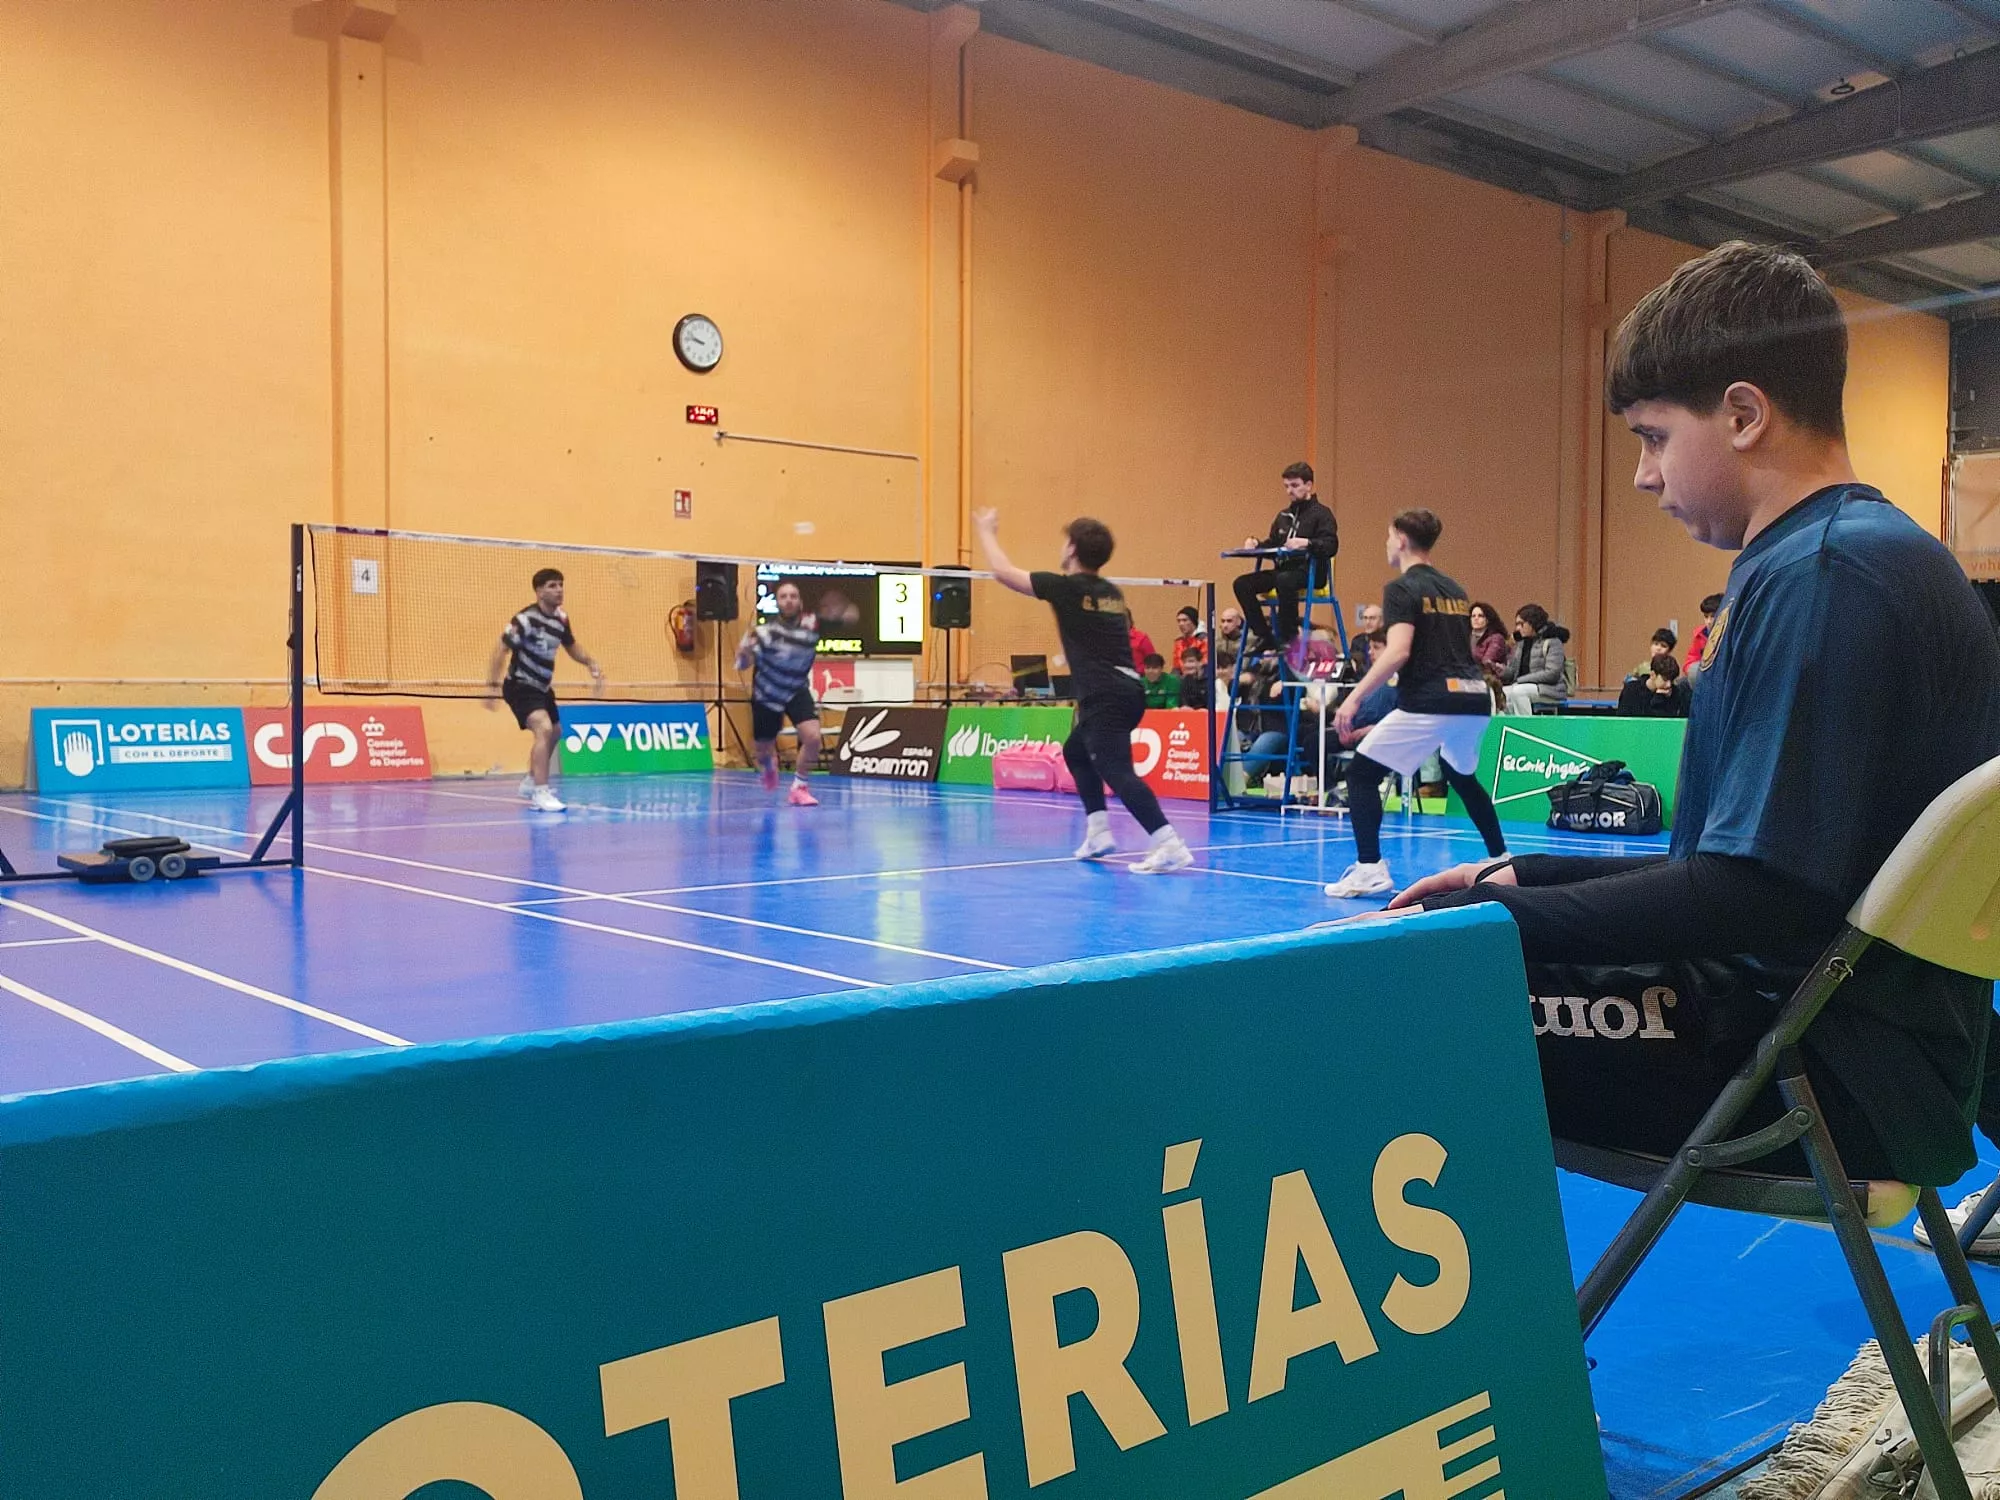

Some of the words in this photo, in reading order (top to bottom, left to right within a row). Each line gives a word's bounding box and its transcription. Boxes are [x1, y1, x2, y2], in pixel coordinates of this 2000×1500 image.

[361, 568, 371, 582] 4
[895, 582, 908, 603] 3
[898, 616, 904, 634] 1
[107, 719, 231, 742] LOTERÍAS
[617, 722, 702, 752] YONEX
[124, 750, 149, 759] CON
[153, 749, 165, 757] EL
[169, 748, 219, 757] DEPORTE
[367, 738, 404, 751] Consejo
[850, 756, 929, 777] BADMINTON
[1503, 755, 1516, 771] El
[1516, 756, 1545, 773] Corte
